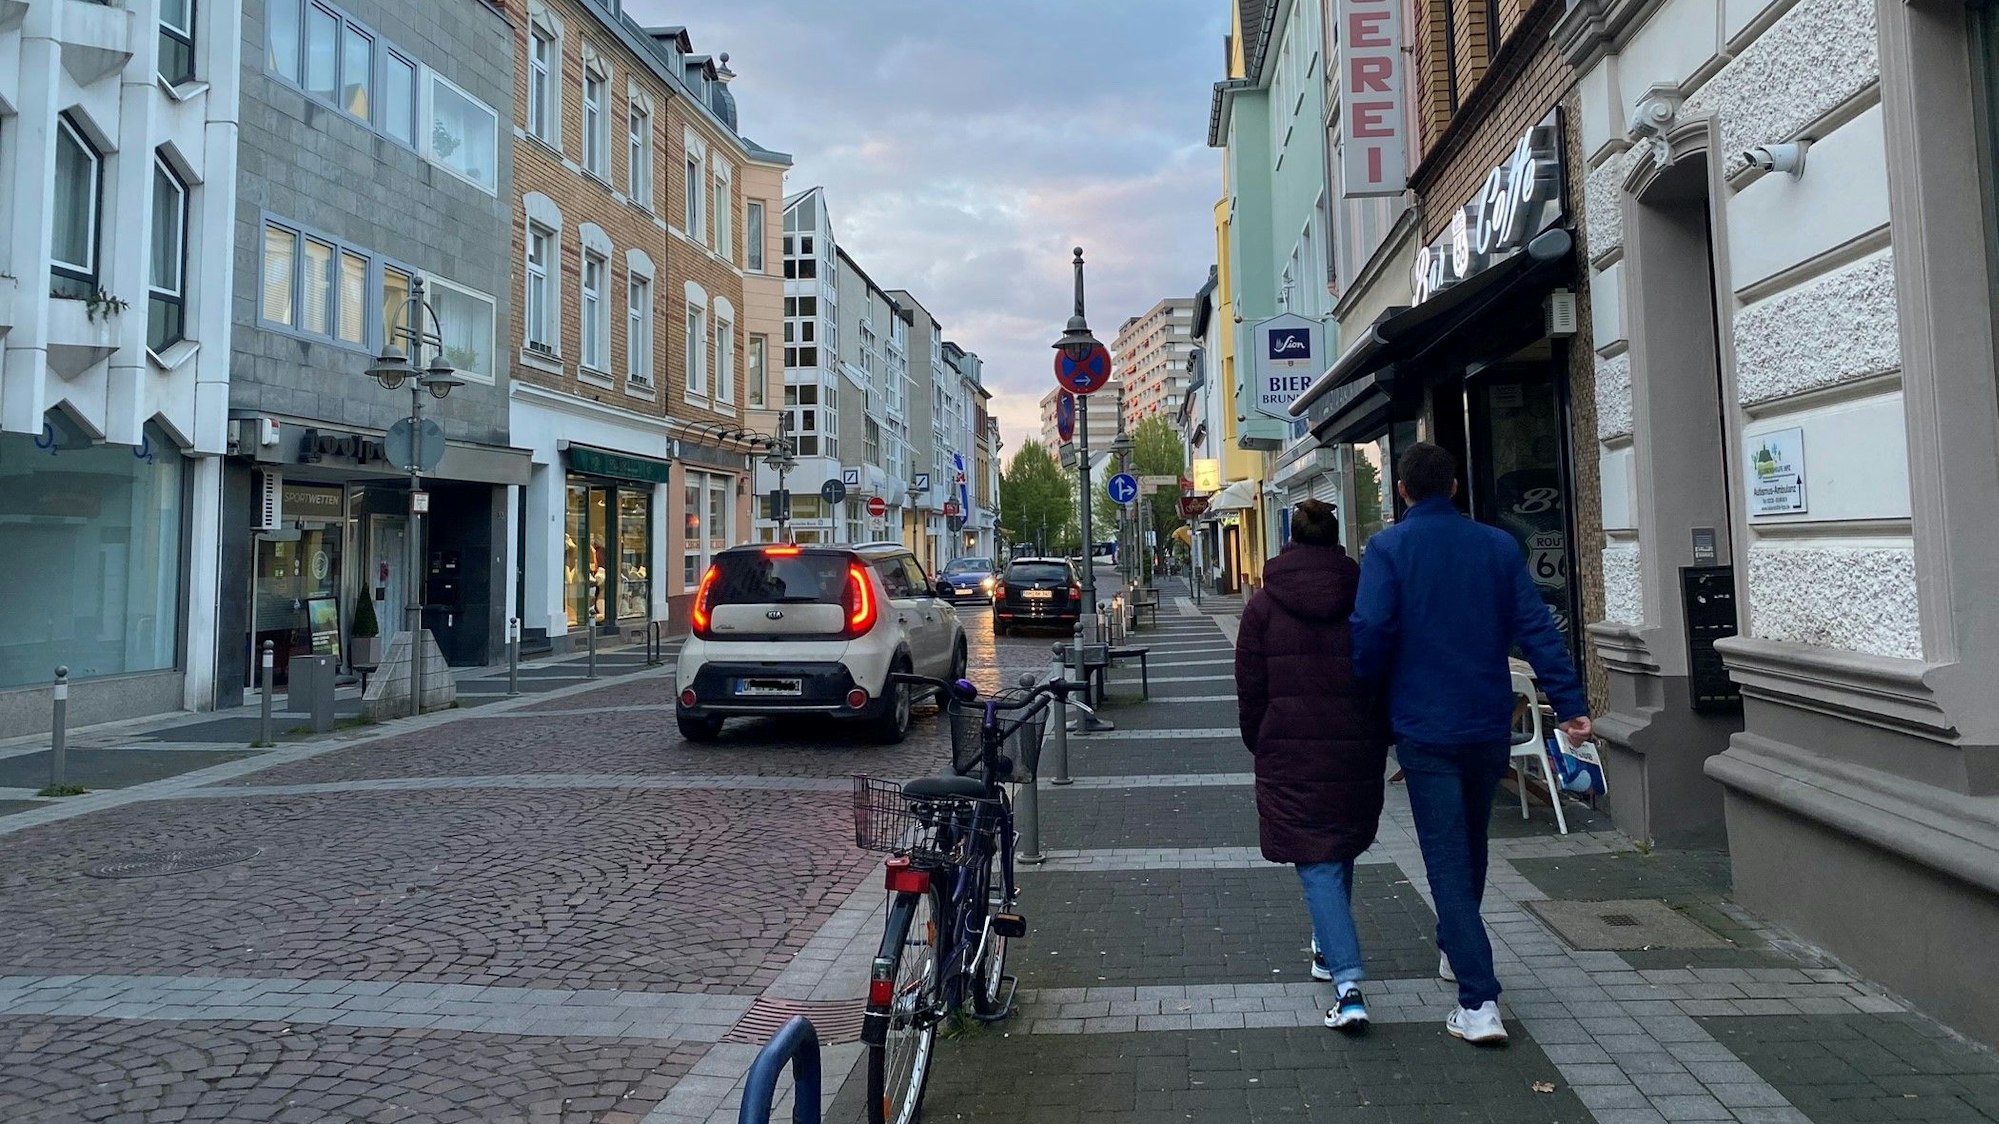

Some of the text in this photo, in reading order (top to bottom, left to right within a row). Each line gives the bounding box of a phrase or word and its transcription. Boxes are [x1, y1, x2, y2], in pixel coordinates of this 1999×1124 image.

[1349, 0, 1394, 183] EREI
[1412, 245, 1445, 308] Bar
[1274, 335, 1305, 352] Sion
[1269, 376, 1312, 391] BIER
[284, 491, 340, 505] SPORTWETTEN
[1513, 487, 1561, 514] B
